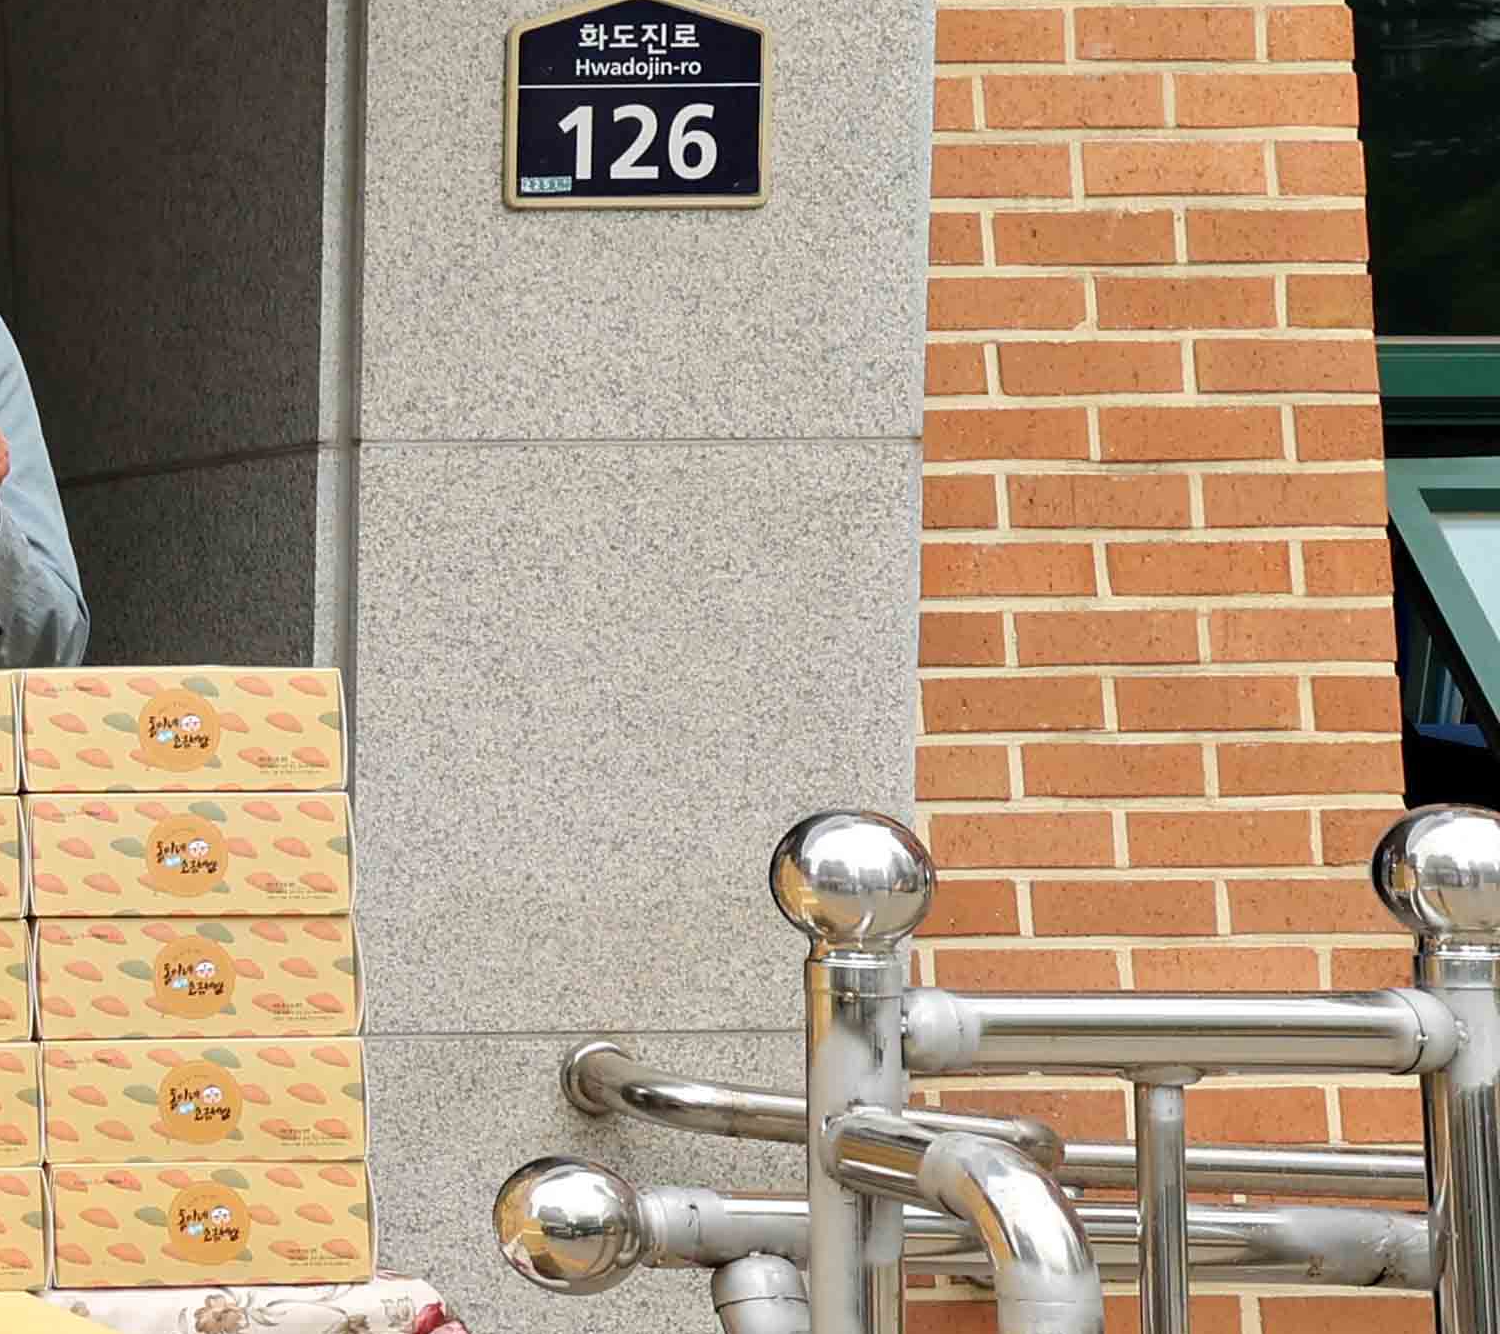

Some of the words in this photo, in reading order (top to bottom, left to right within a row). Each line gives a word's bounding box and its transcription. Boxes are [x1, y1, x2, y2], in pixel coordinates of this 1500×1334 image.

[579, 23, 700, 53] 화도진로
[575, 57, 702, 79] Hwadojin-ro
[558, 103, 719, 181] 126
